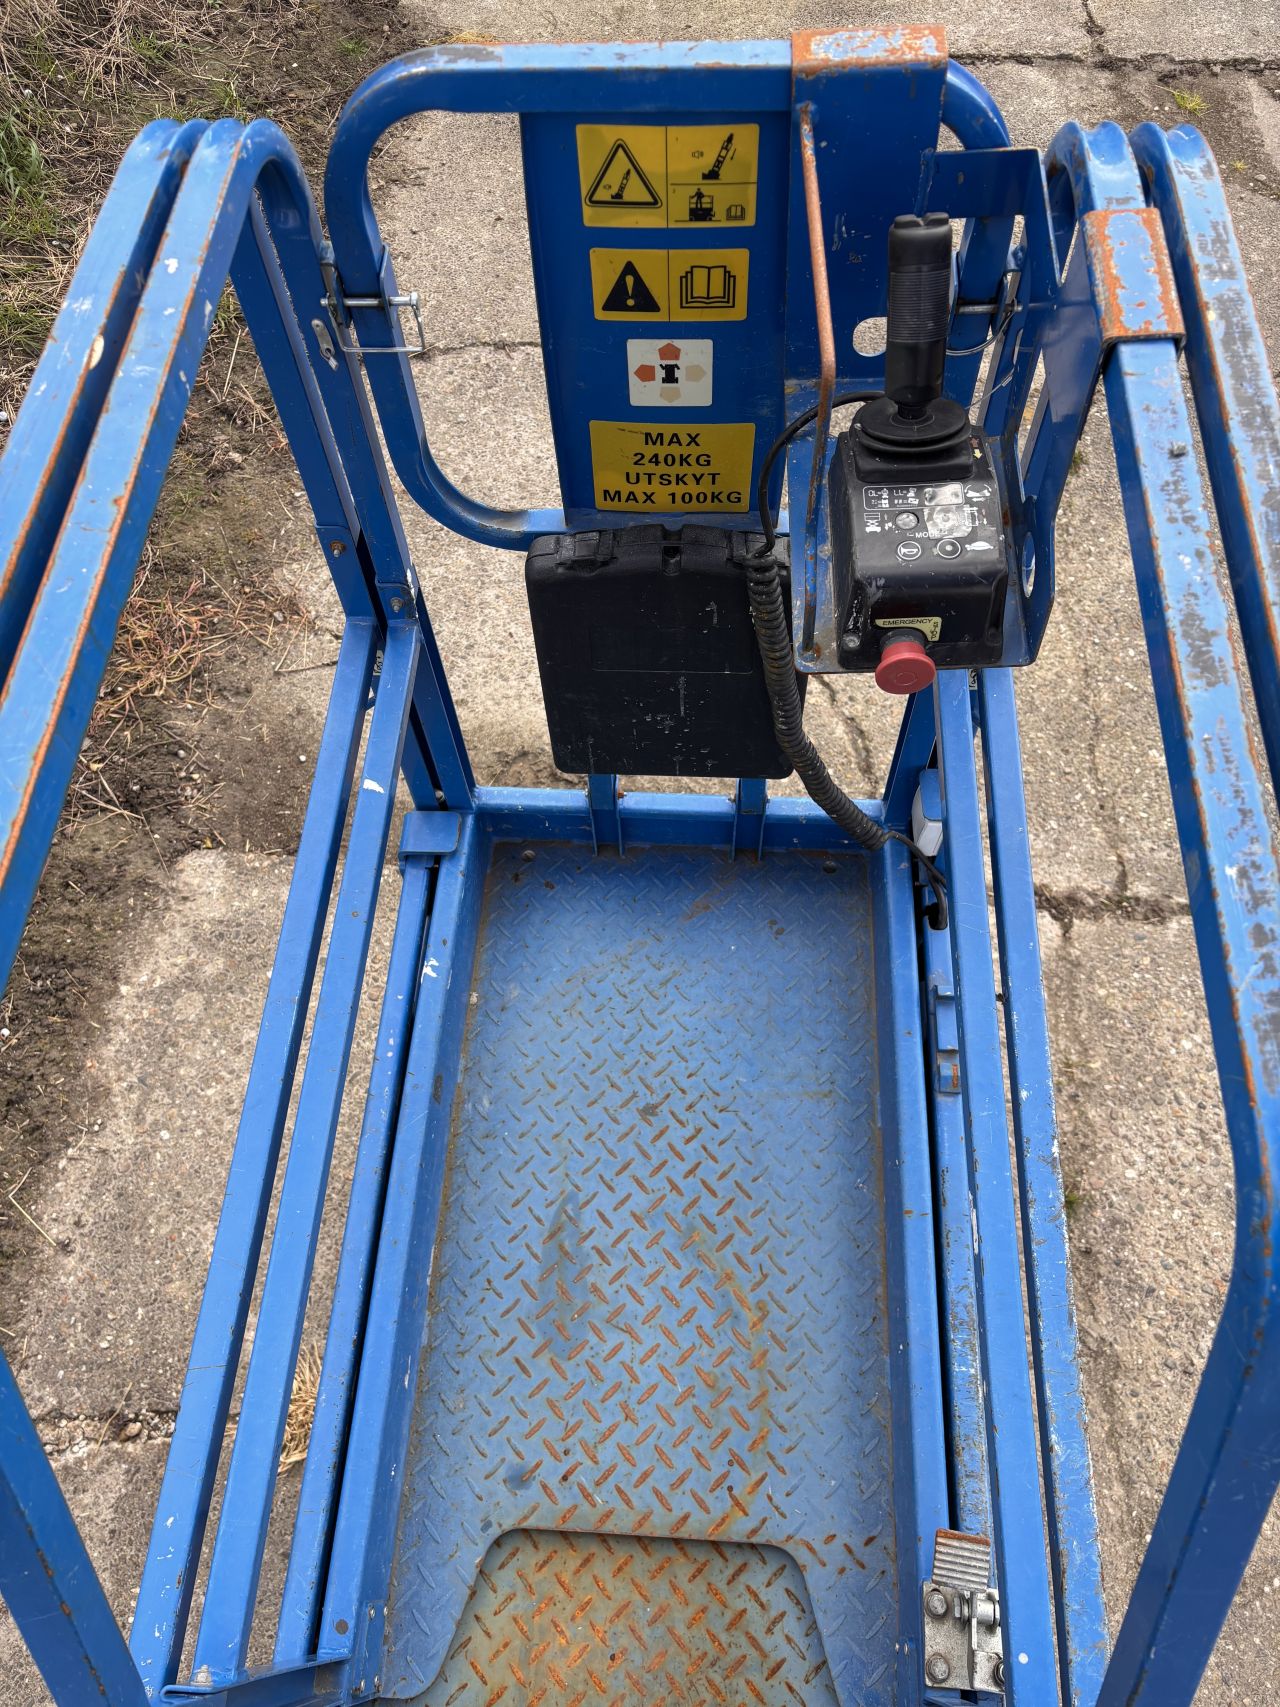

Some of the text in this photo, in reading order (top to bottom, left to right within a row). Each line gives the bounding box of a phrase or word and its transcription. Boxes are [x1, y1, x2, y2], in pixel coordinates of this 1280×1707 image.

[644, 432, 701, 447] MAX
[632, 452, 712, 467] 240KG
[625, 471, 721, 486] UTSKYT
[603, 489, 742, 504] MAX 100KG
[882, 618, 933, 626] EMERGENCY
